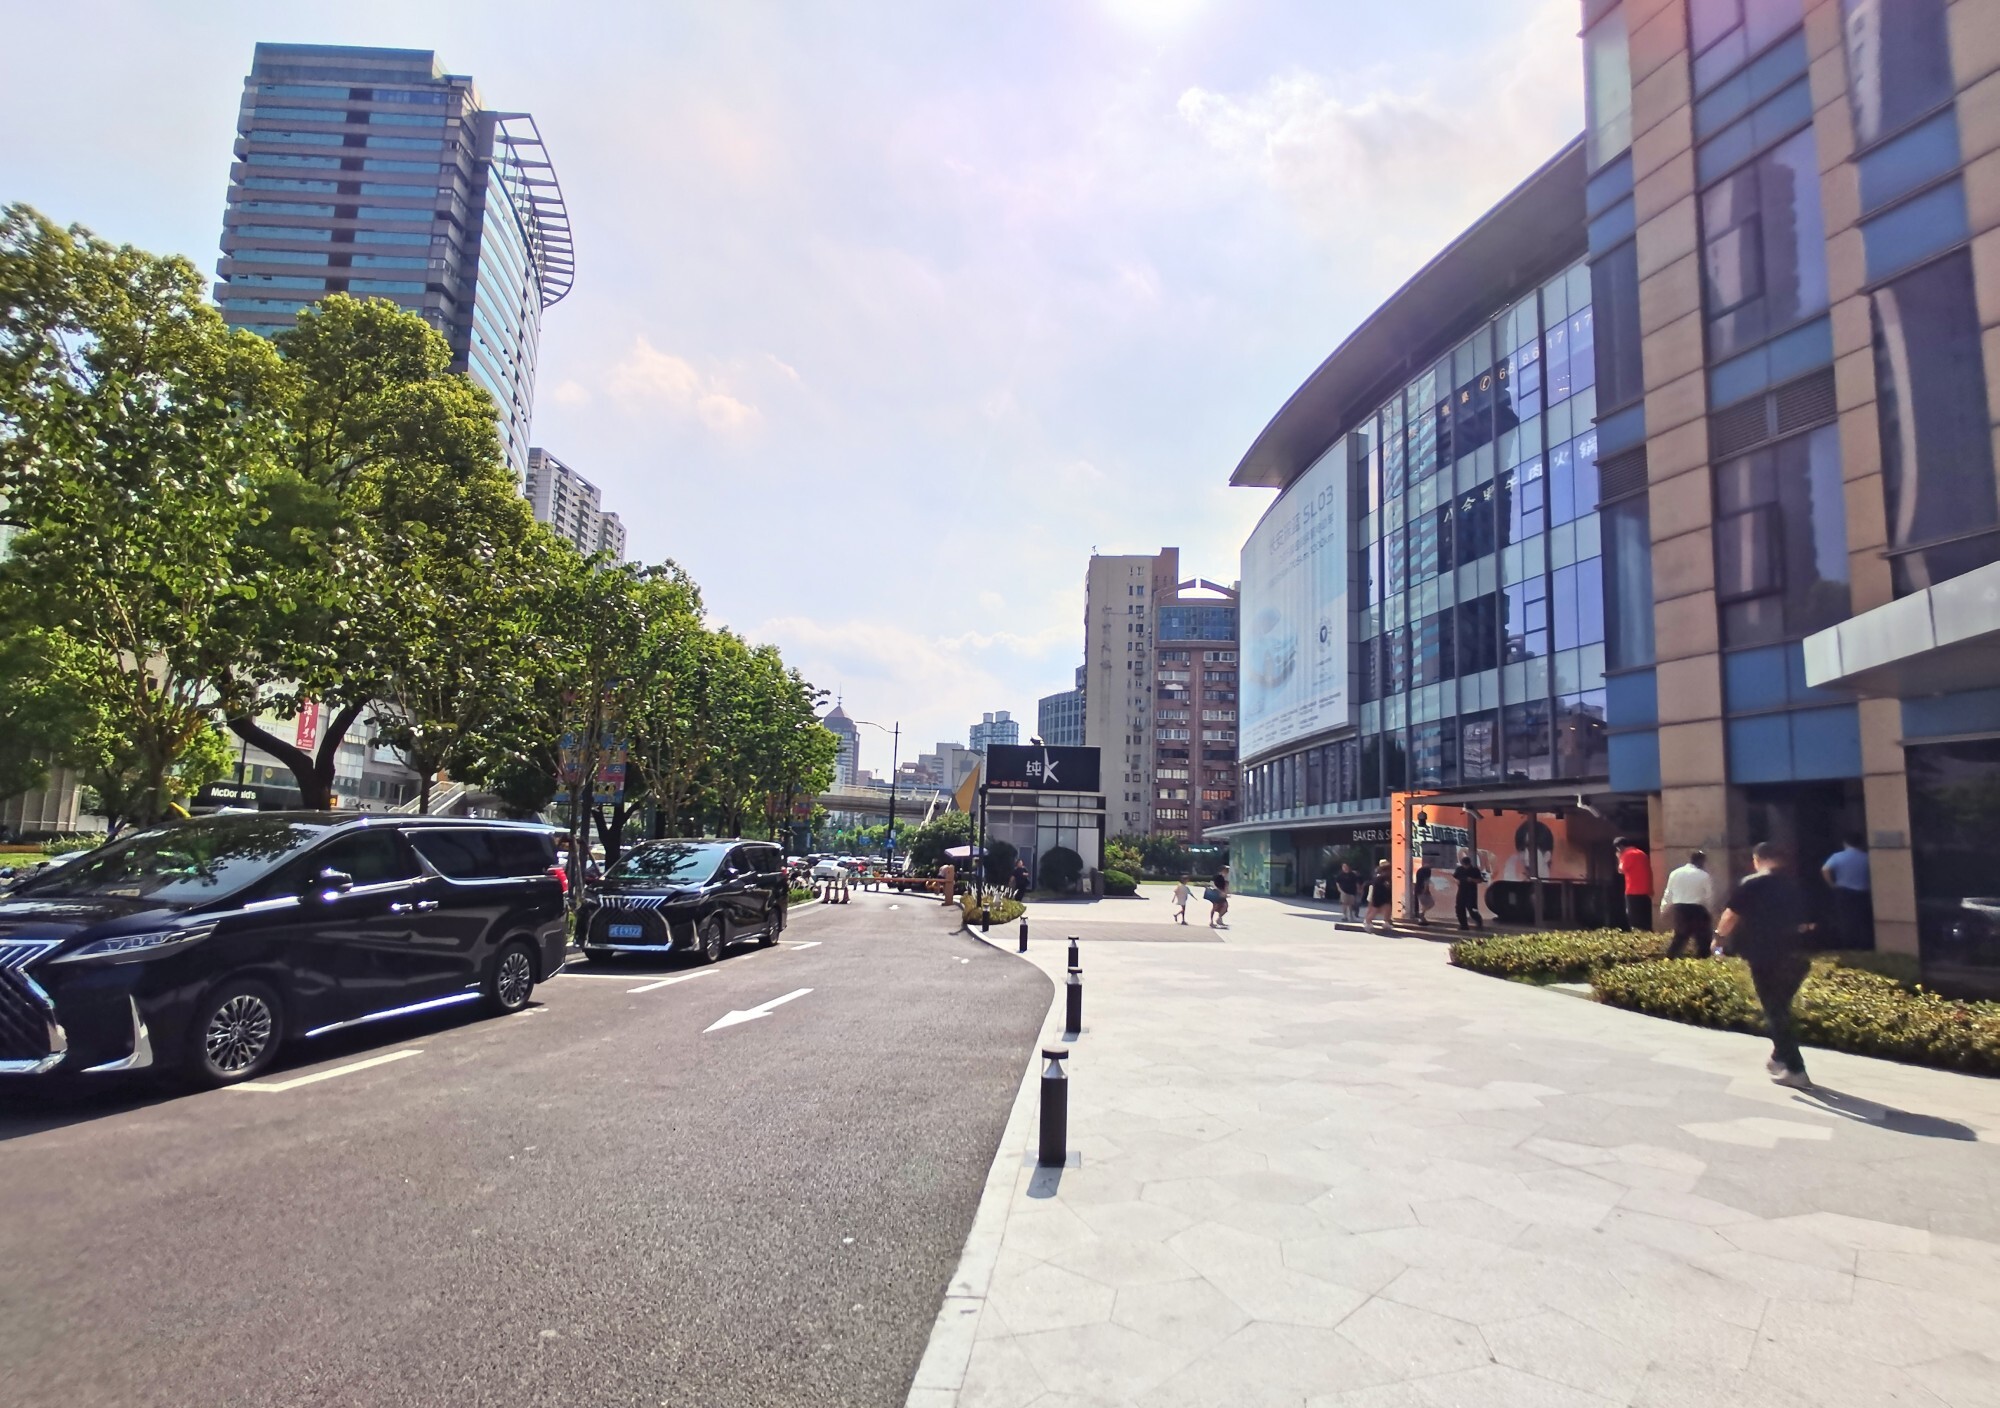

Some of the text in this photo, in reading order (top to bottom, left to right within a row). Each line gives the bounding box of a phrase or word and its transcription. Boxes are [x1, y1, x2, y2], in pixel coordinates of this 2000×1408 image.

[1303, 484, 1334, 525] SL03
[1025, 747, 1060, 784] 纯K
[1352, 829, 1377, 842] BAKER
